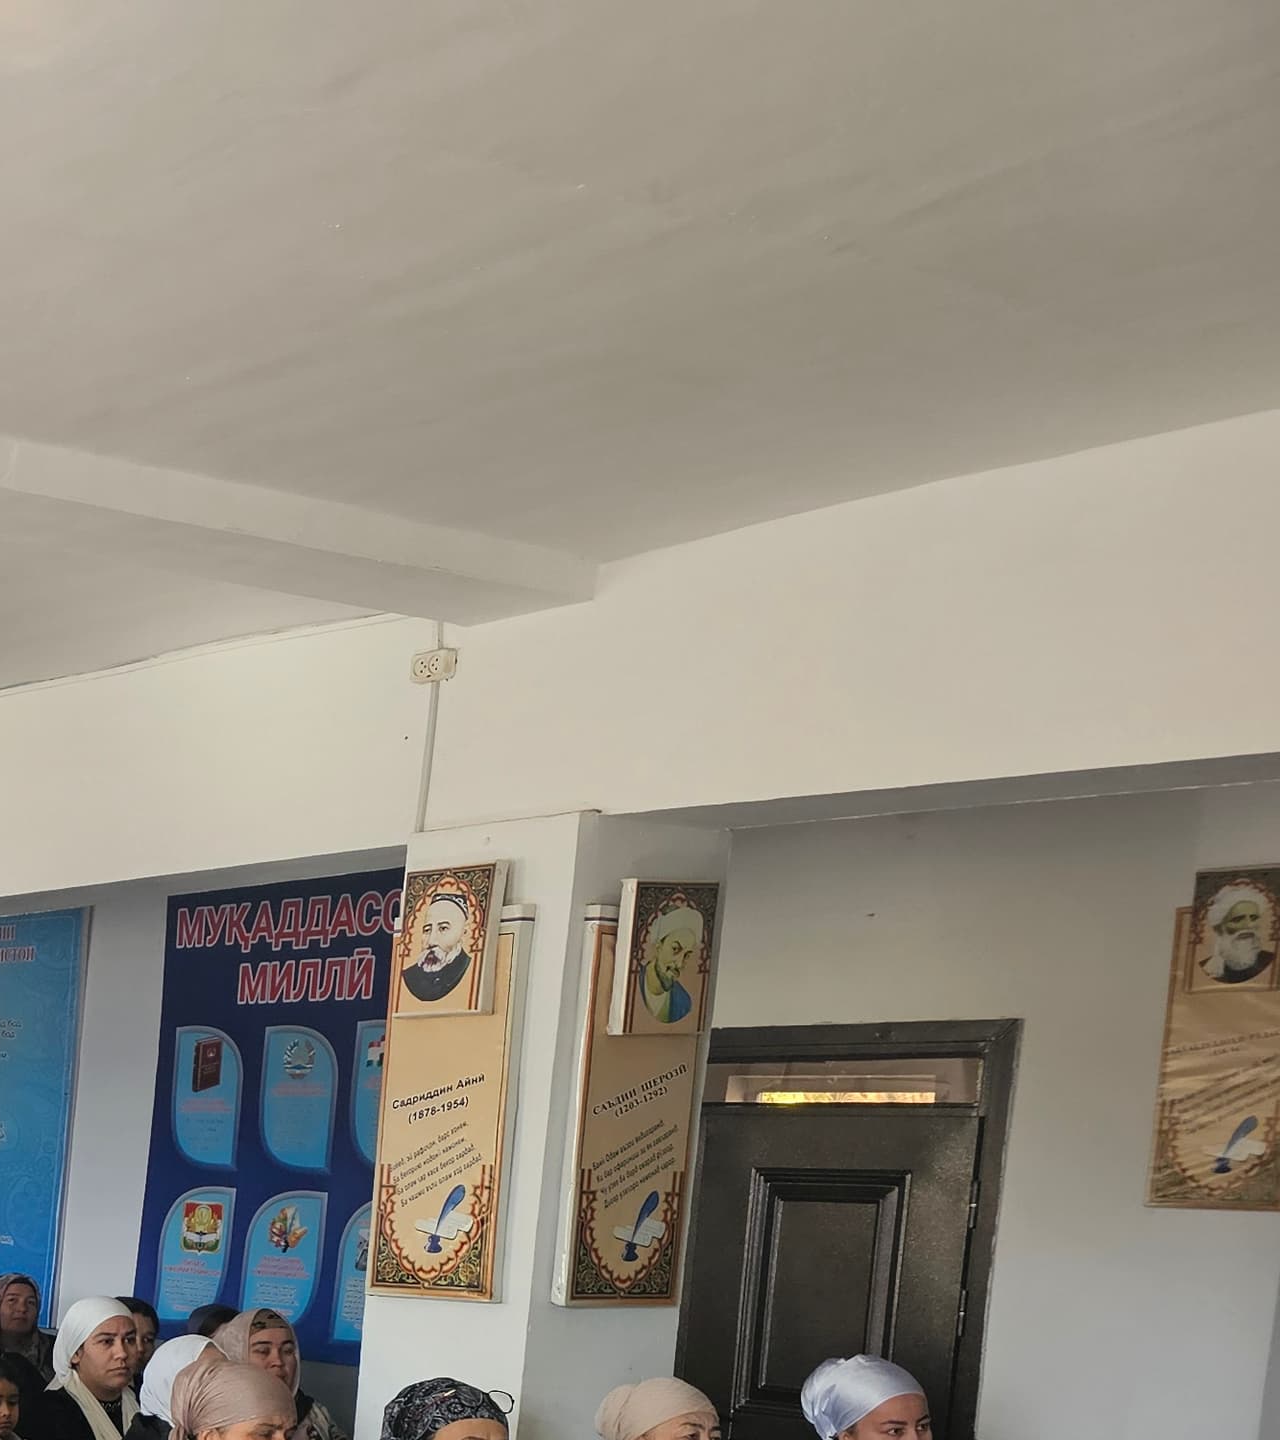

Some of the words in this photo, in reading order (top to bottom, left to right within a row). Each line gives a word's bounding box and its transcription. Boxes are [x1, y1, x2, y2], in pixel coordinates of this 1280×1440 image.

[237, 948, 376, 1005] МИЛЛӢ
[392, 1083, 453, 1110] Садриддин
[408, 1096, 469, 1124] (1878-1954)
[592, 1087, 637, 1116] САЪДИИ
[614, 1086, 668, 1118] (1203-1292)
